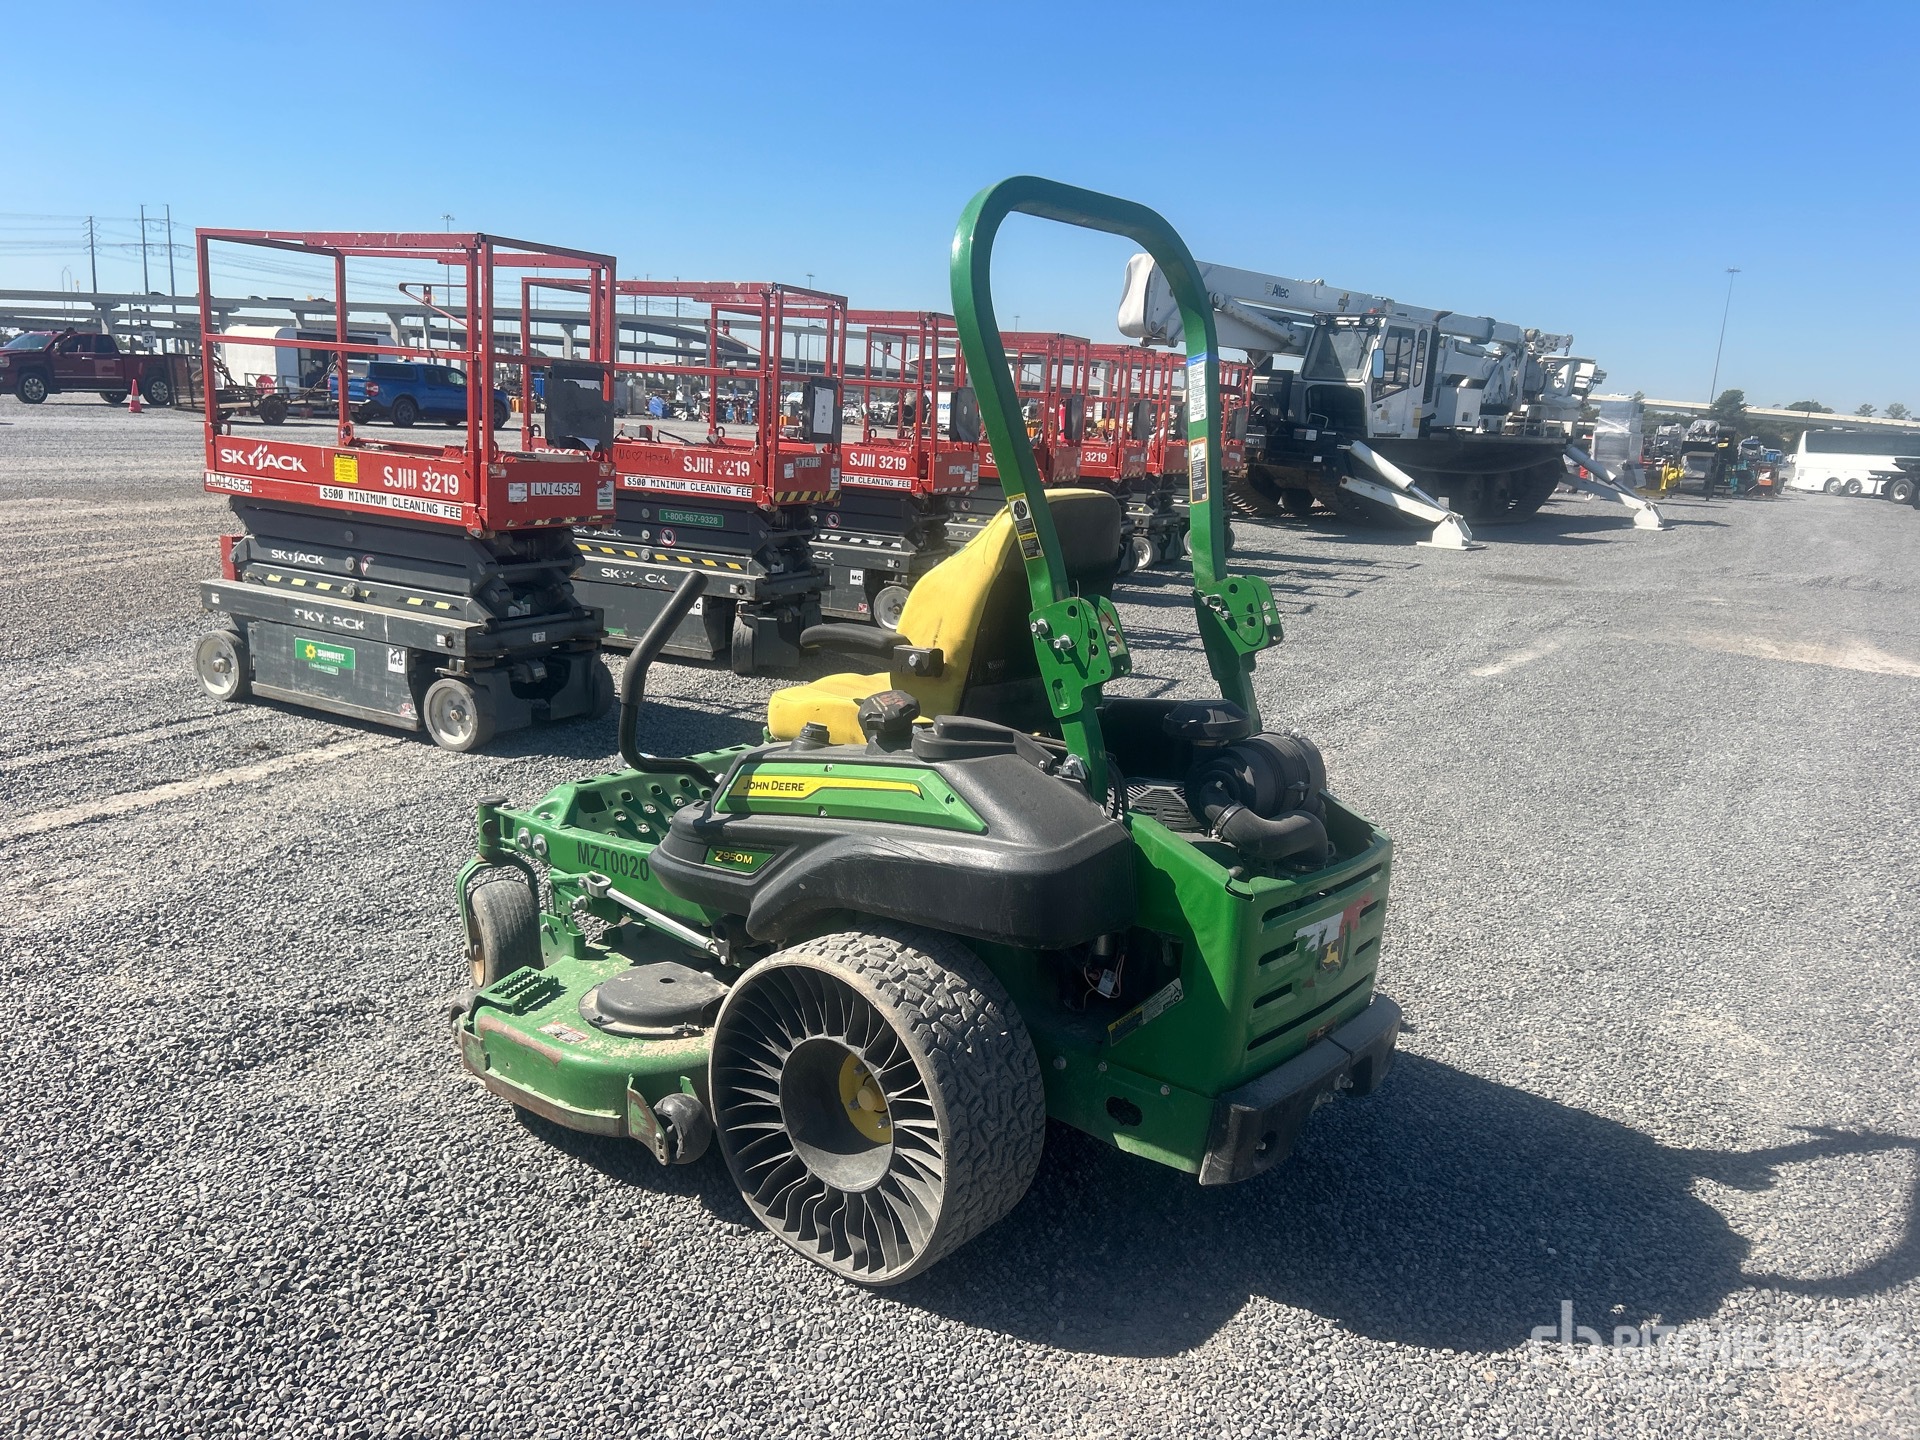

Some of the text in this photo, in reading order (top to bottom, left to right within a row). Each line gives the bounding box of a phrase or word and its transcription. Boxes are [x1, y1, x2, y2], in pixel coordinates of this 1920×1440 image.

[144, 335, 154, 344] 57
[220, 444, 308, 473] SKYJACK
[879, 455, 907, 471] 3219
[1085, 451, 1107, 463] 3219
[422, 470, 459, 496] 3219
[534, 482, 580, 495] LWI4554
[627, 477, 752, 497] $500 MINIMUM CLEANING FEE
[858, 476, 894, 486] CLEANING
[897, 479, 911, 488] FEE
[322, 488, 461, 519] $500 MINIMUM CLEANING FEE
[664, 511, 718, 525] 1-800-667-9328
[743, 779, 805, 792] JOHN DEERE
[577, 841, 650, 882] MZT0020
[714, 850, 753, 865] Z950M
